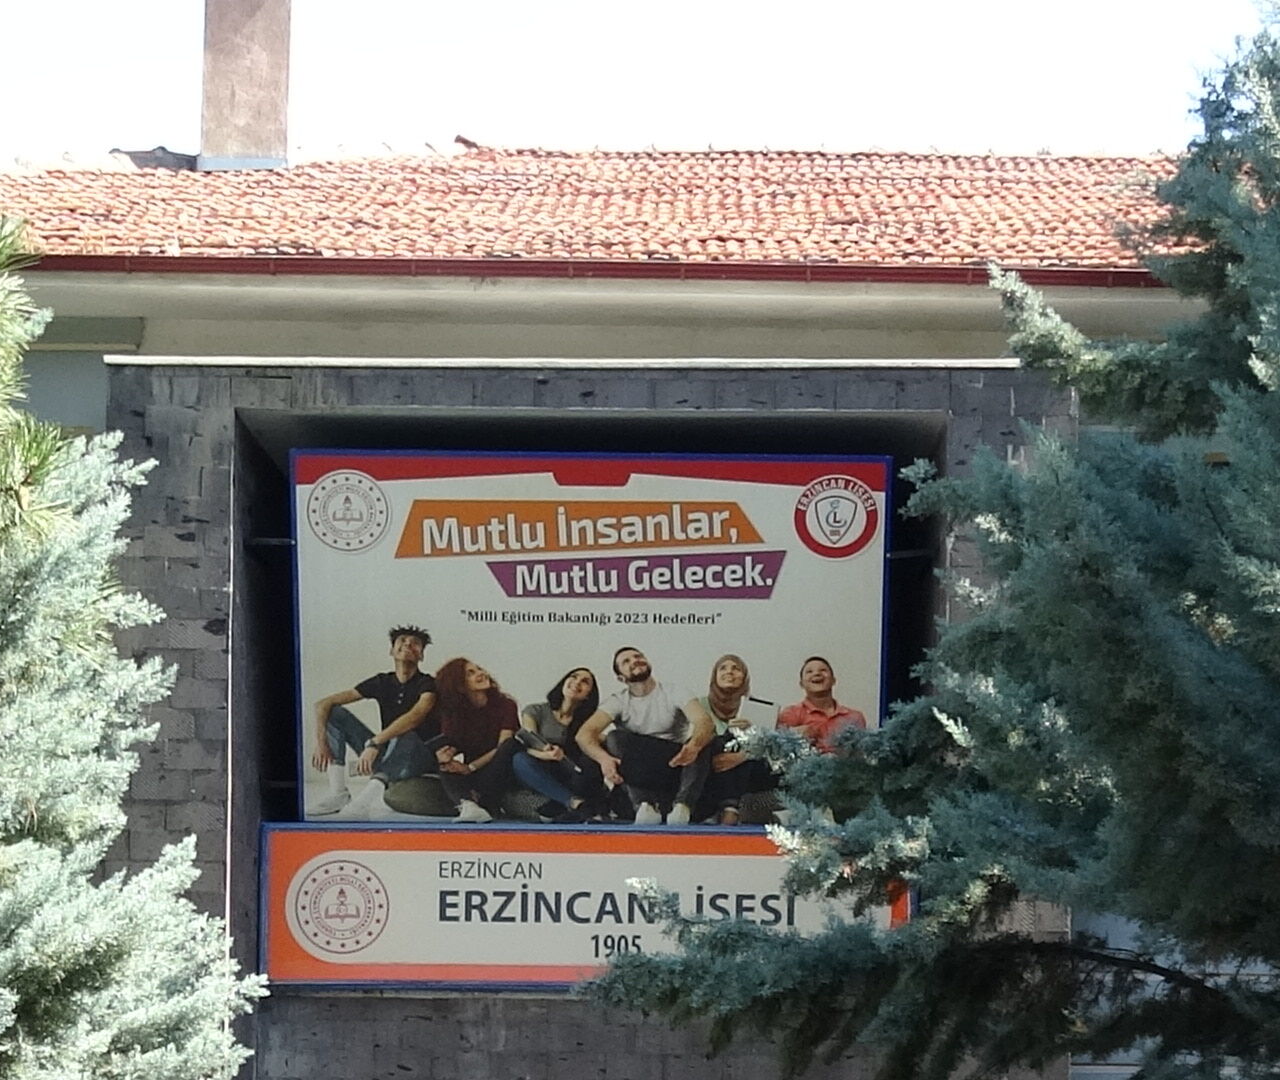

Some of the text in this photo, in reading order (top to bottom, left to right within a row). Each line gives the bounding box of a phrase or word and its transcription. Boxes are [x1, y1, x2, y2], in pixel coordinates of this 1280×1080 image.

[422, 505, 738, 555] Mutlu İnsanlar,
[516, 556, 773, 595] Mutlu Gelecek.
[502, 611, 544, 625] Eğitim
[548, 611, 611, 626] Bakanlığı
[615, 612, 648, 624] 2023
[438, 858, 543, 880] ERZİNCAN
[438, 883, 657, 925] ERZİNCAN
[590, 934, 643, 958] 1905
